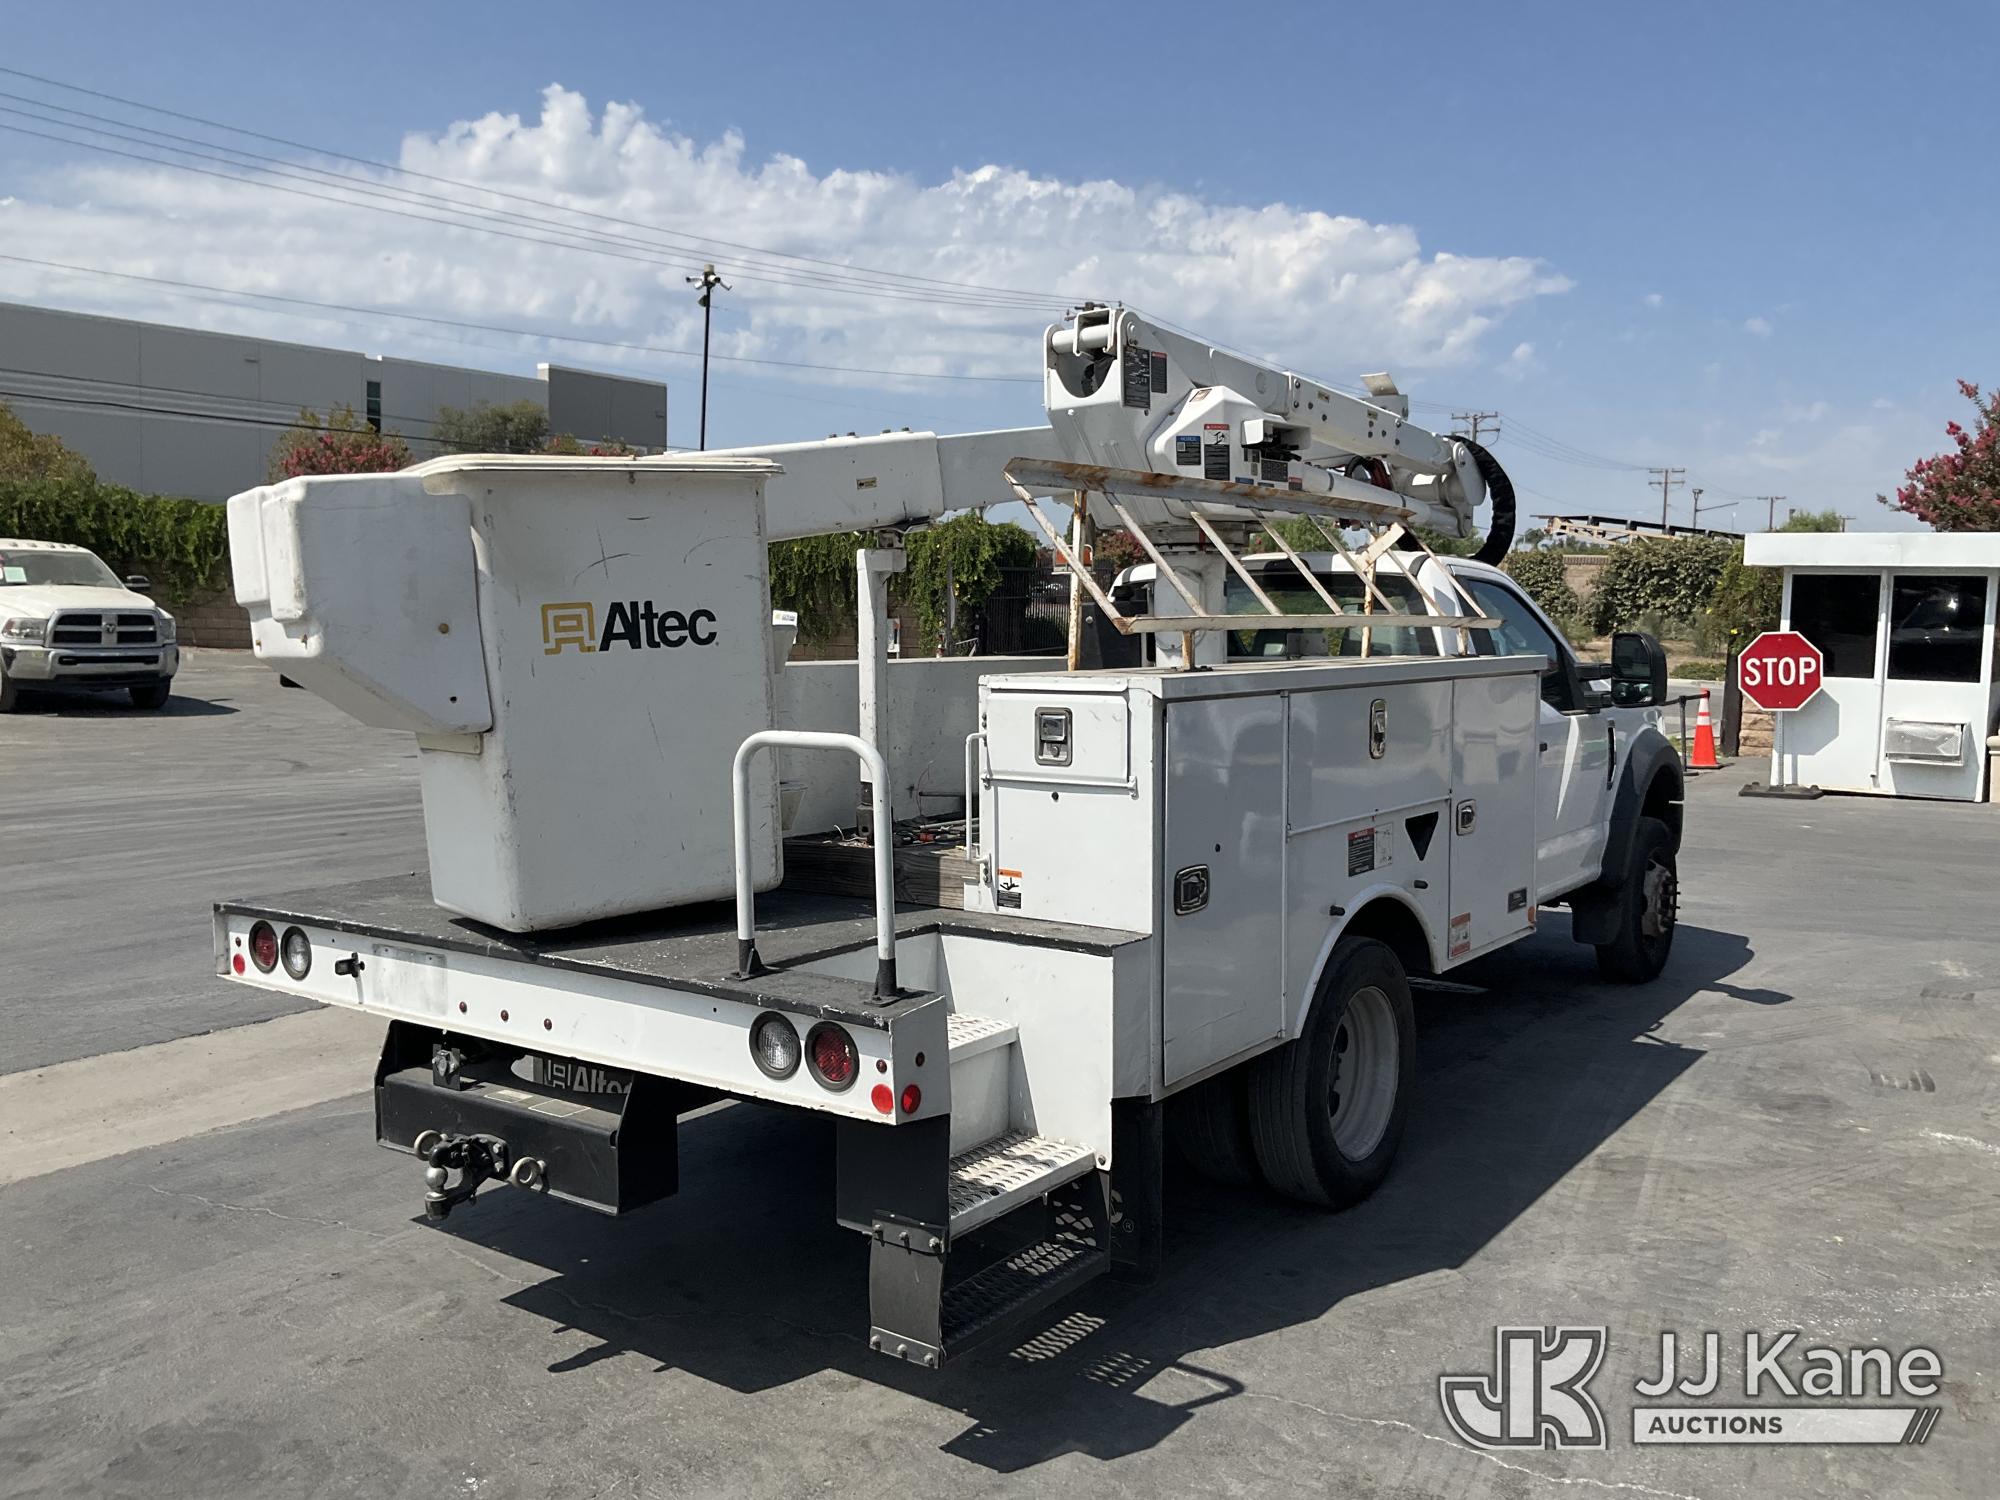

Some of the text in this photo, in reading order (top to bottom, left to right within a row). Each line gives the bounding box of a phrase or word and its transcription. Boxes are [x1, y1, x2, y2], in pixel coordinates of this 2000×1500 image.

[599, 600, 718, 652] Altec
[1744, 656, 1817, 687] STOP
[572, 1066, 632, 1094] Alt
